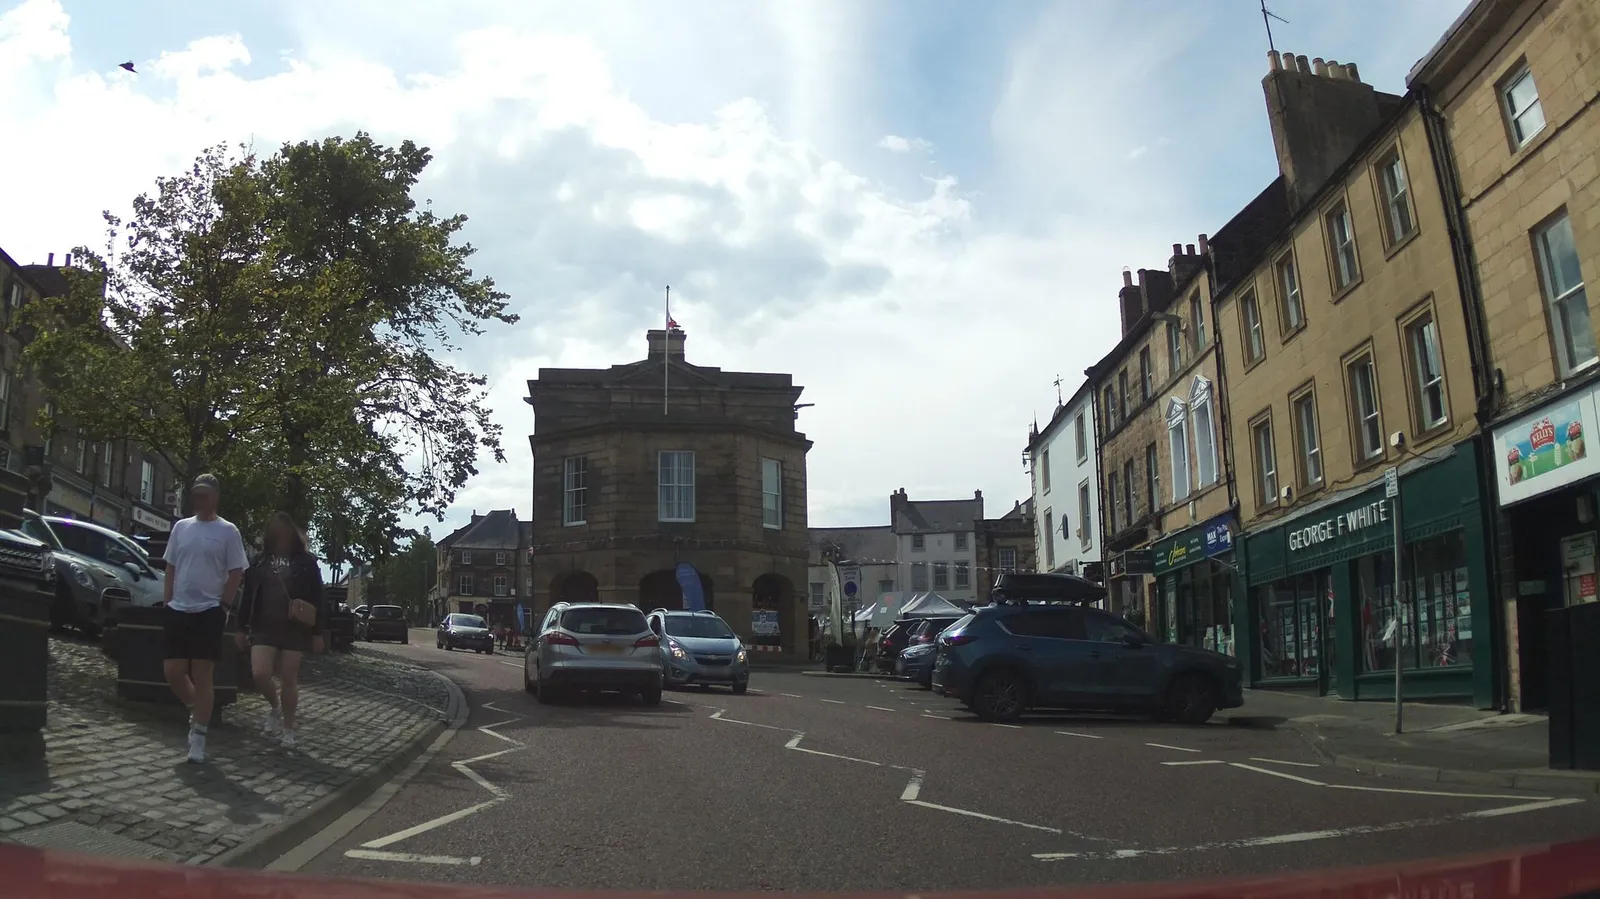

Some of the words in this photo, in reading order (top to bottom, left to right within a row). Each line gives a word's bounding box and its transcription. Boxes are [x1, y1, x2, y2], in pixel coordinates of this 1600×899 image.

[1289, 519, 1335, 551] GEORGE
[1337, 515, 1345, 536] F
[1346, 499, 1388, 532] WHITE
